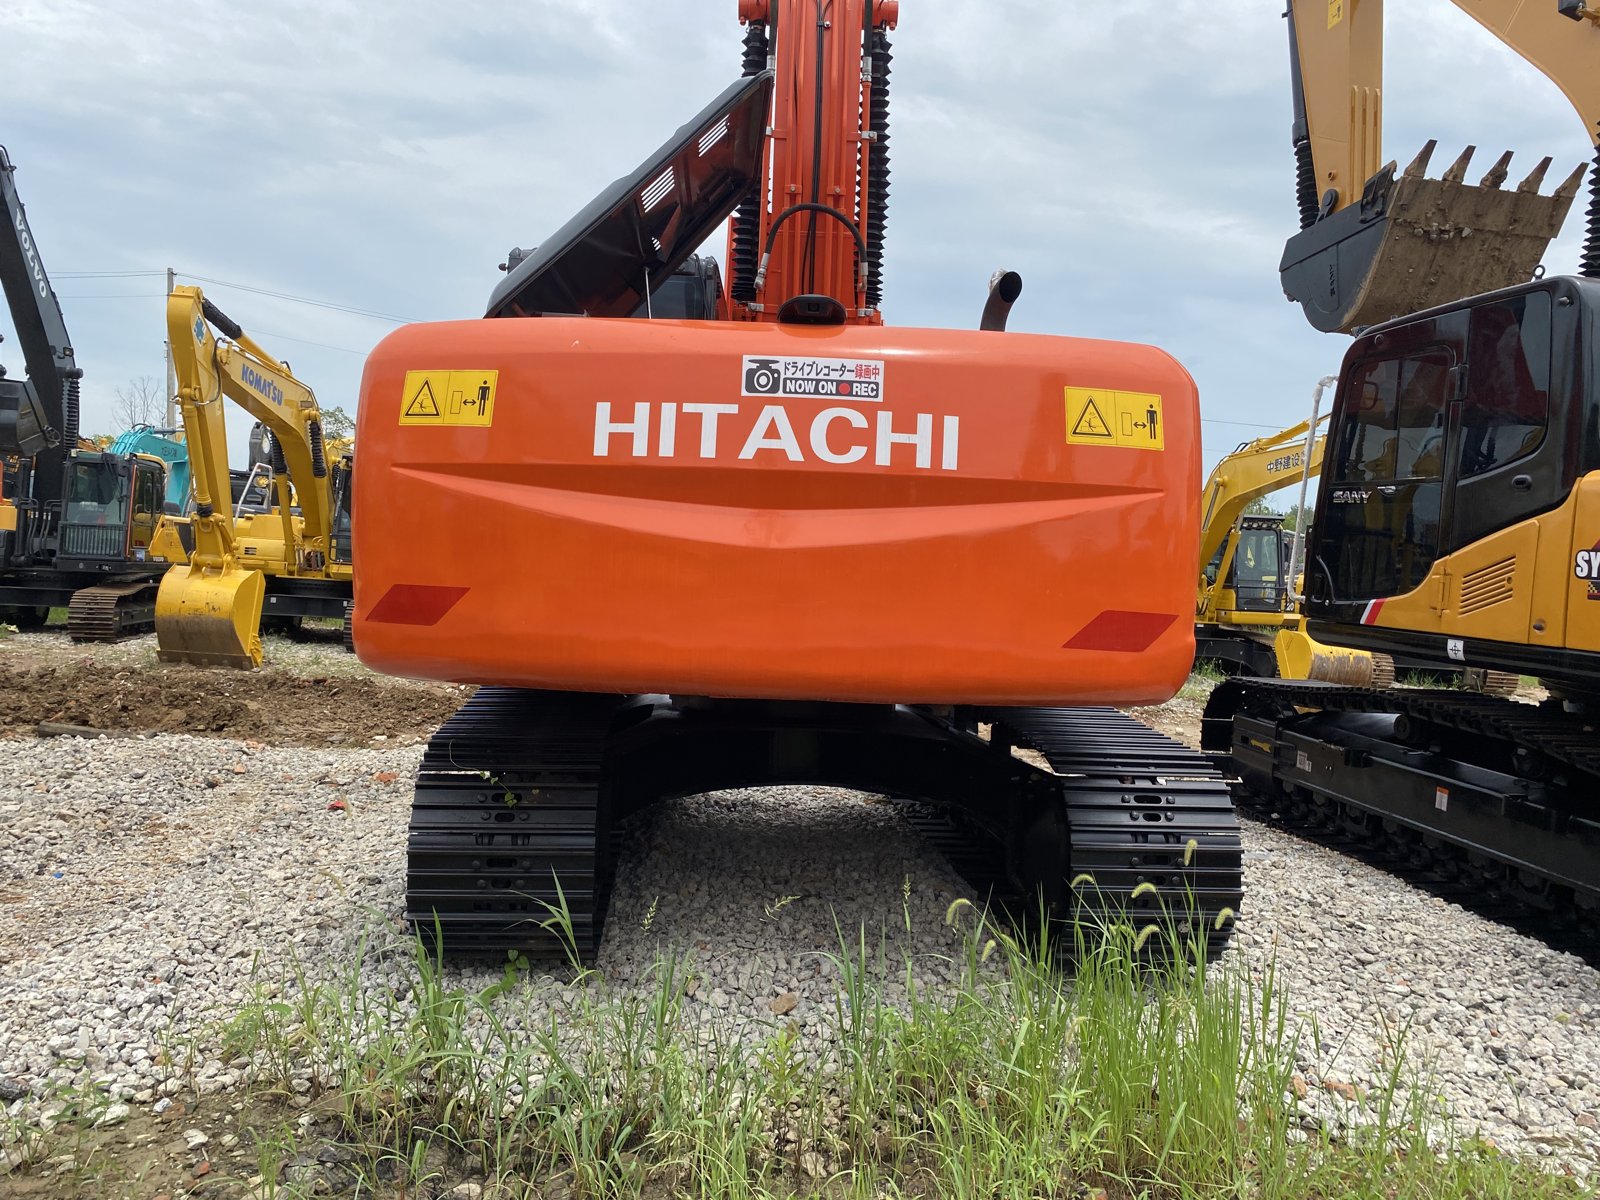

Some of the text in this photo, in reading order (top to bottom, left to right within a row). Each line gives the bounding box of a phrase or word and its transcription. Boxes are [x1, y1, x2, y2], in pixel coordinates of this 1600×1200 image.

[16, 208, 46, 297] VOLVO
[241, 363, 284, 407] KOMATSU
[786, 379, 877, 397] NOW ON REC
[593, 401, 960, 471] HITACHI
[1333, 490, 1373, 504] SANY
